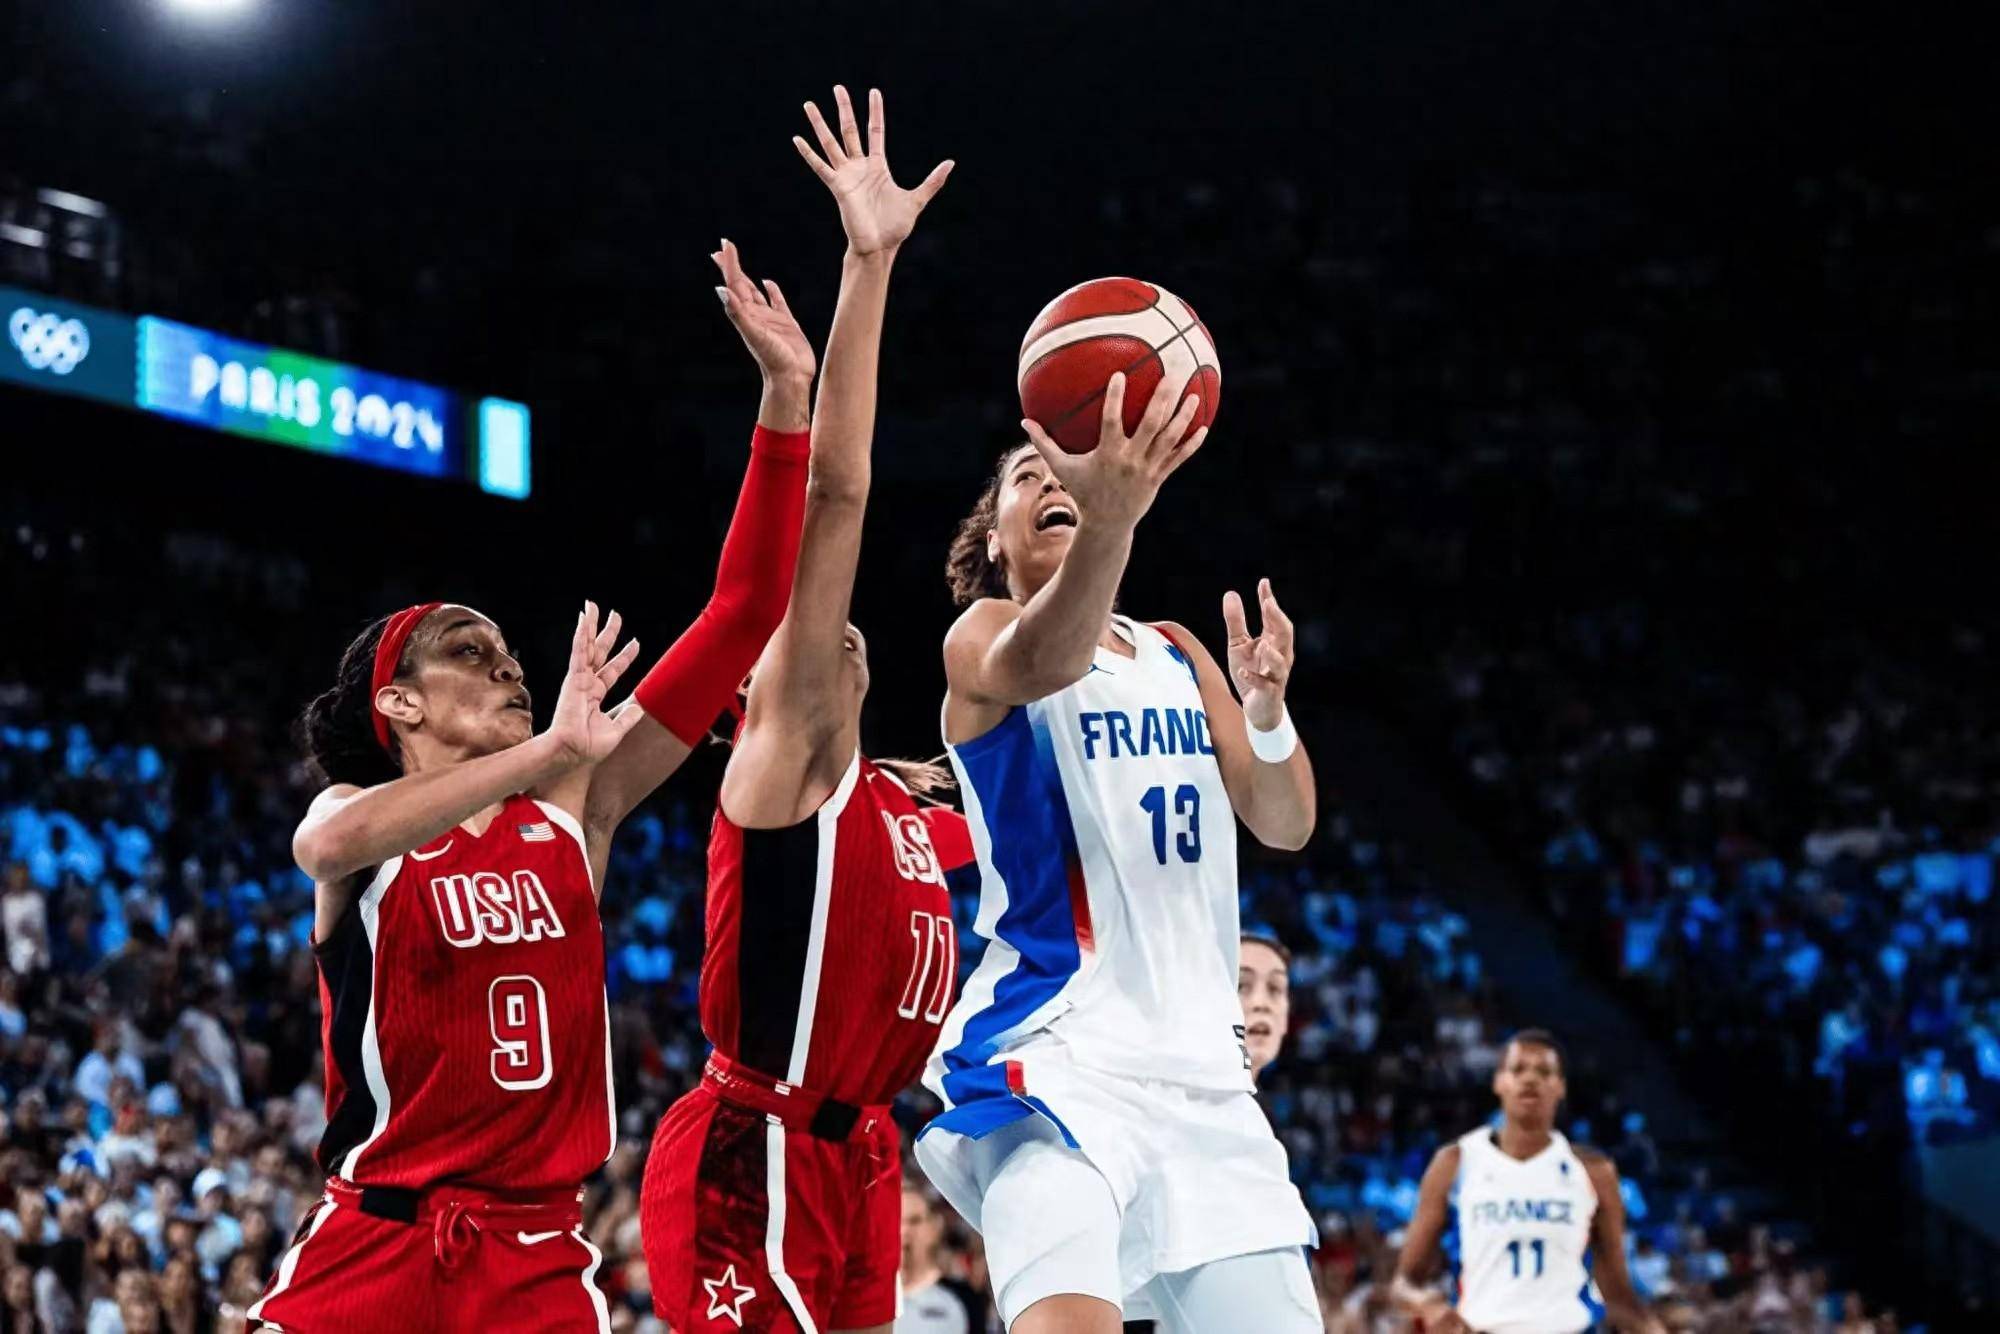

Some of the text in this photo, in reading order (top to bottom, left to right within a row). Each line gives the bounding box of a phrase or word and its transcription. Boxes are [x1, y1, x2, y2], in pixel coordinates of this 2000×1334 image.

[191, 354, 443, 454] PARIS 2024
[1079, 708, 1215, 760] FRANC
[881, 809, 948, 891] US
[1139, 784, 1201, 865] 13
[431, 869, 565, 948] USA
[898, 912, 955, 1025] 11
[488, 975, 553, 1091] 9
[1472, 1199, 1573, 1225] FRANCE
[1505, 1239, 1547, 1278] 11
